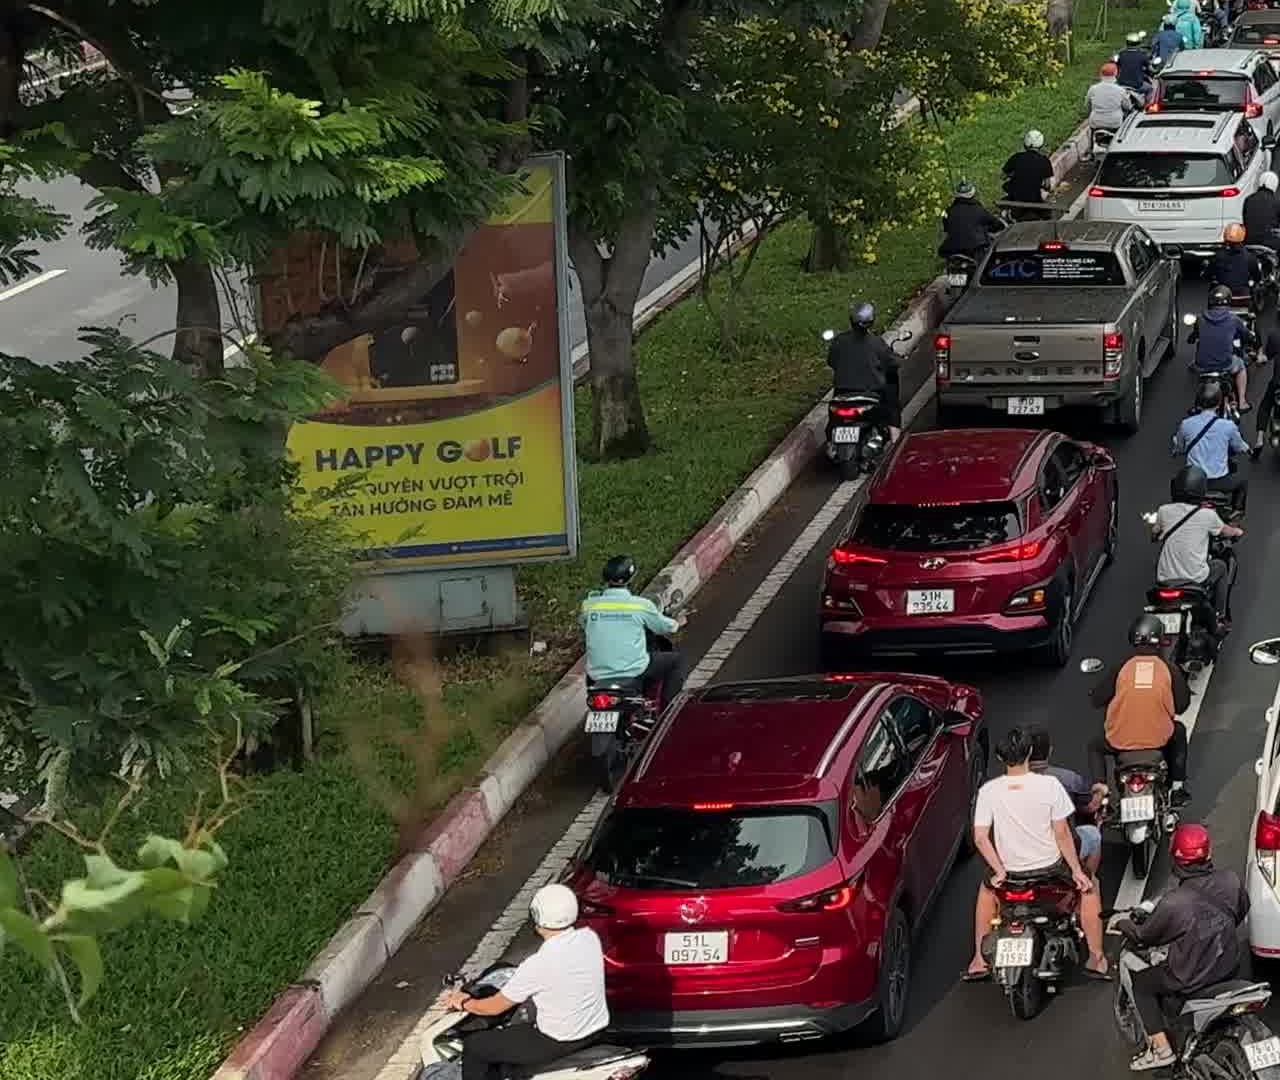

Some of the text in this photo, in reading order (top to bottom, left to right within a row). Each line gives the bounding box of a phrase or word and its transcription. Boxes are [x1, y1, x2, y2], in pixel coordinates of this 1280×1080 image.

[315, 442, 424, 472] HAPPY
[429, 474, 477, 493] VƯỢT
[481, 469, 525, 488] TRỘI
[443, 495, 482, 510] ĐAM
[920, 591, 941, 601] 51H
[682, 935, 709, 948] 51L
